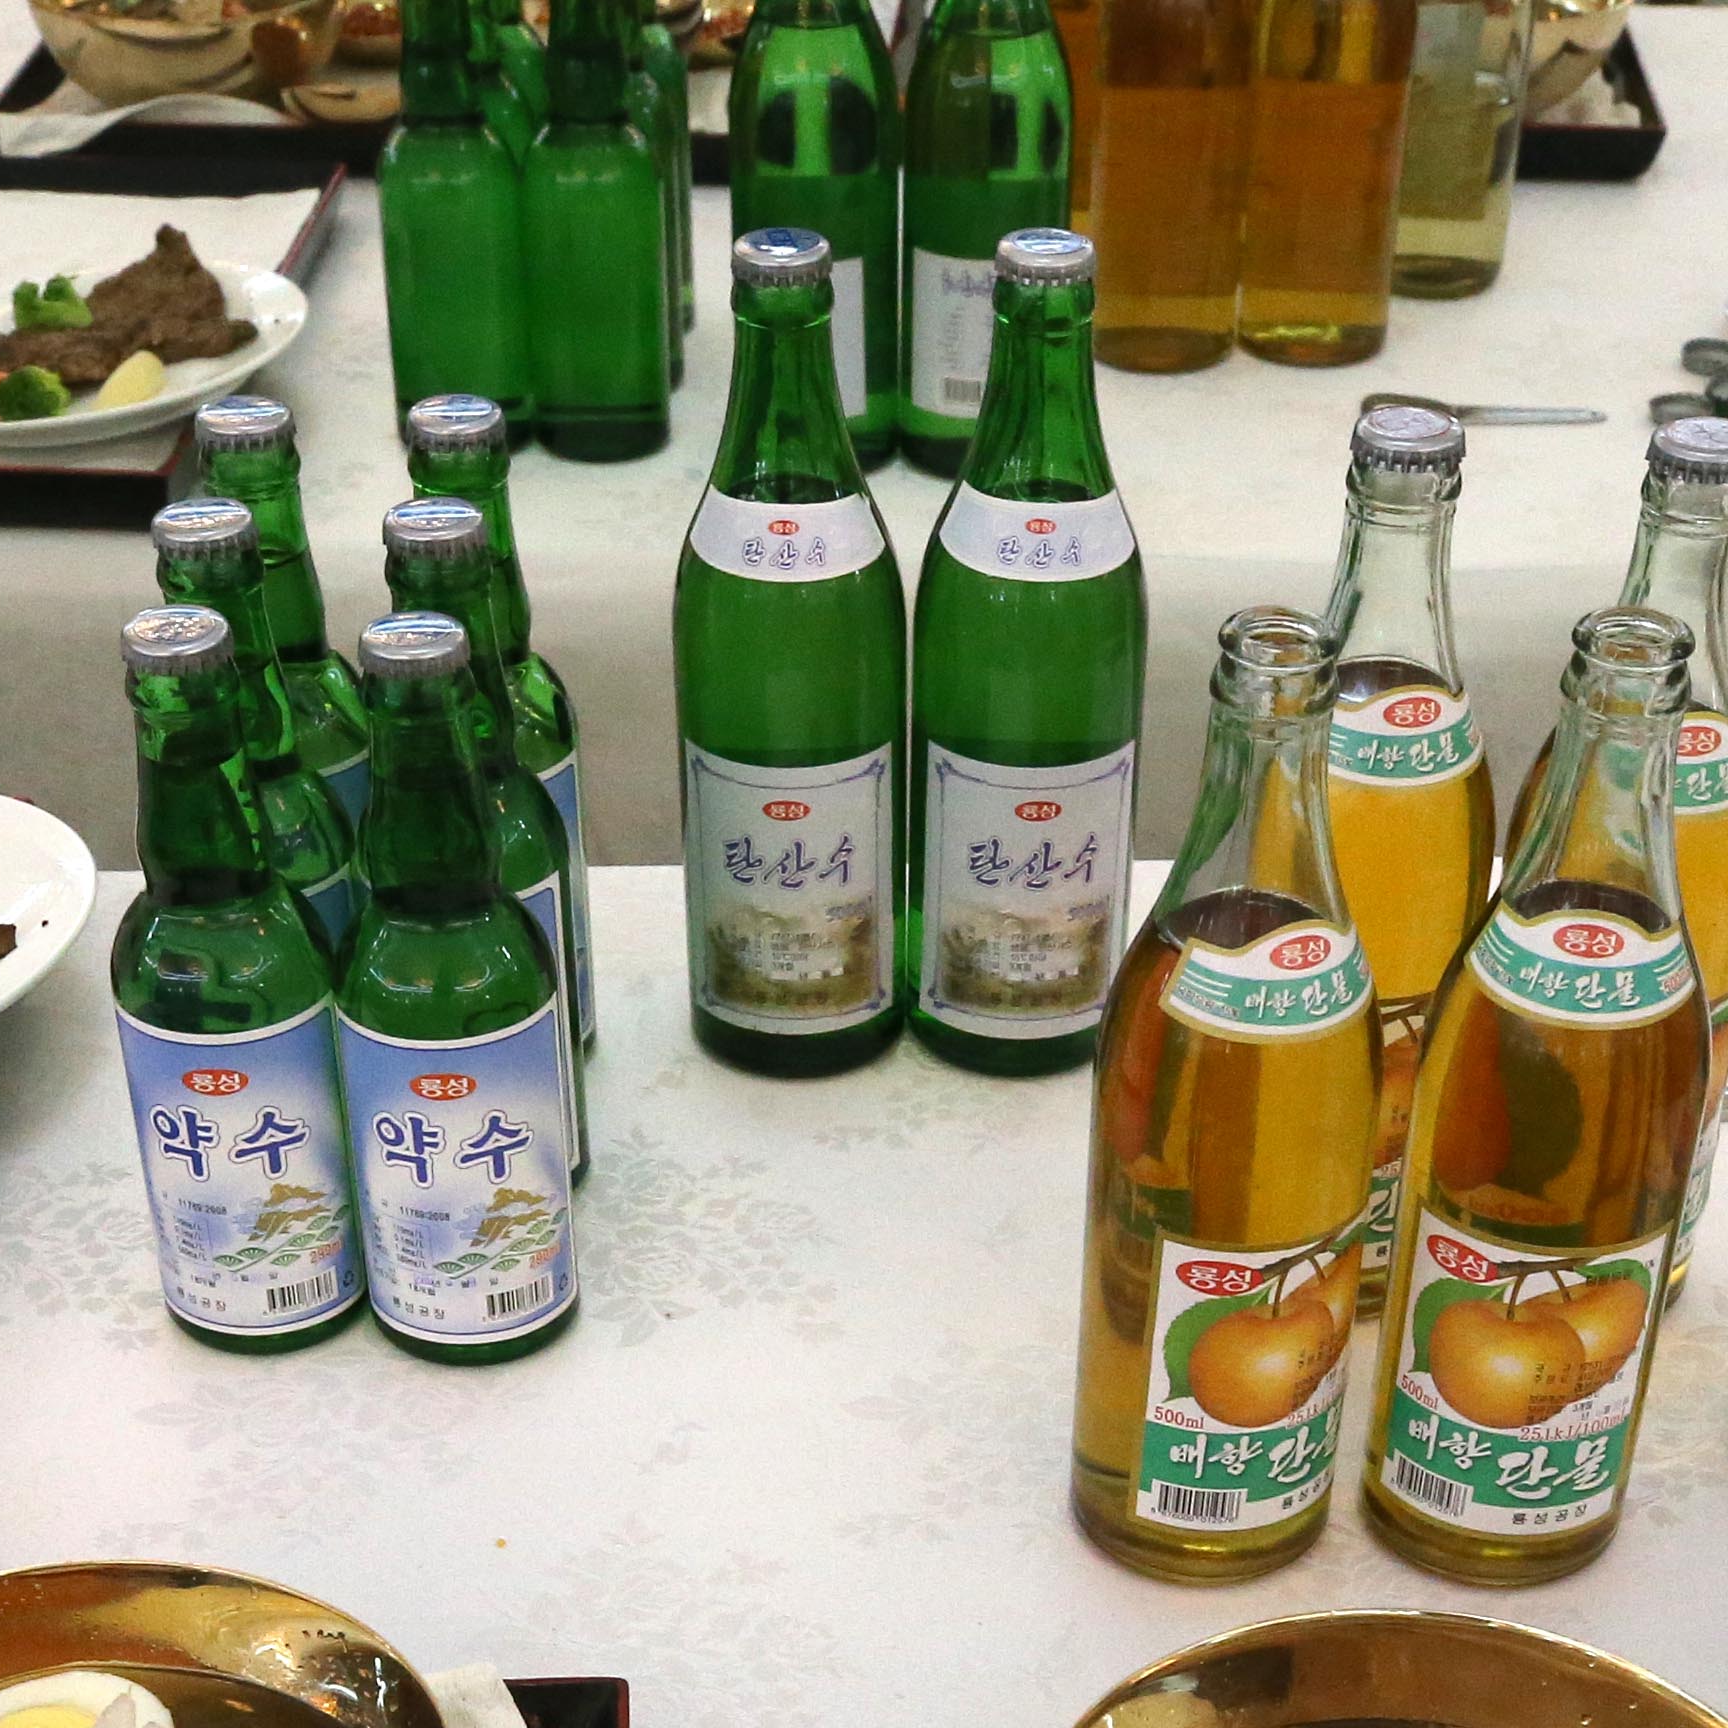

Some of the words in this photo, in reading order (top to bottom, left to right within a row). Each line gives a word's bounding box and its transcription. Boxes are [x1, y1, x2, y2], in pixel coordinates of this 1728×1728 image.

[743, 537, 825, 569] 탄산수
[998, 537, 1081, 568] 탄산수
[1392, 702, 1435, 725] 룡성
[771, 805, 804, 818] 룡성
[1022, 806, 1056, 818] 룡성
[724, 832, 856, 890] 탄산수
[969, 832, 1098, 889] 탄산수
[1280, 939, 1325, 967] 룡성
[1564, 929, 1617, 955] 룡성
[191, 1072, 241, 1093] 룡성
[419, 1078, 469, 1098] 룡성
[151, 1105, 309, 1180] 약수
[374, 1112, 533, 1188] 약수
[1435, 1240, 1488, 1281] 룡성
[1187, 1266, 1252, 1292] 룡성
[1401, 1375, 1439, 1410] 500ml
[1154, 1406, 1204, 1429] 500ml
